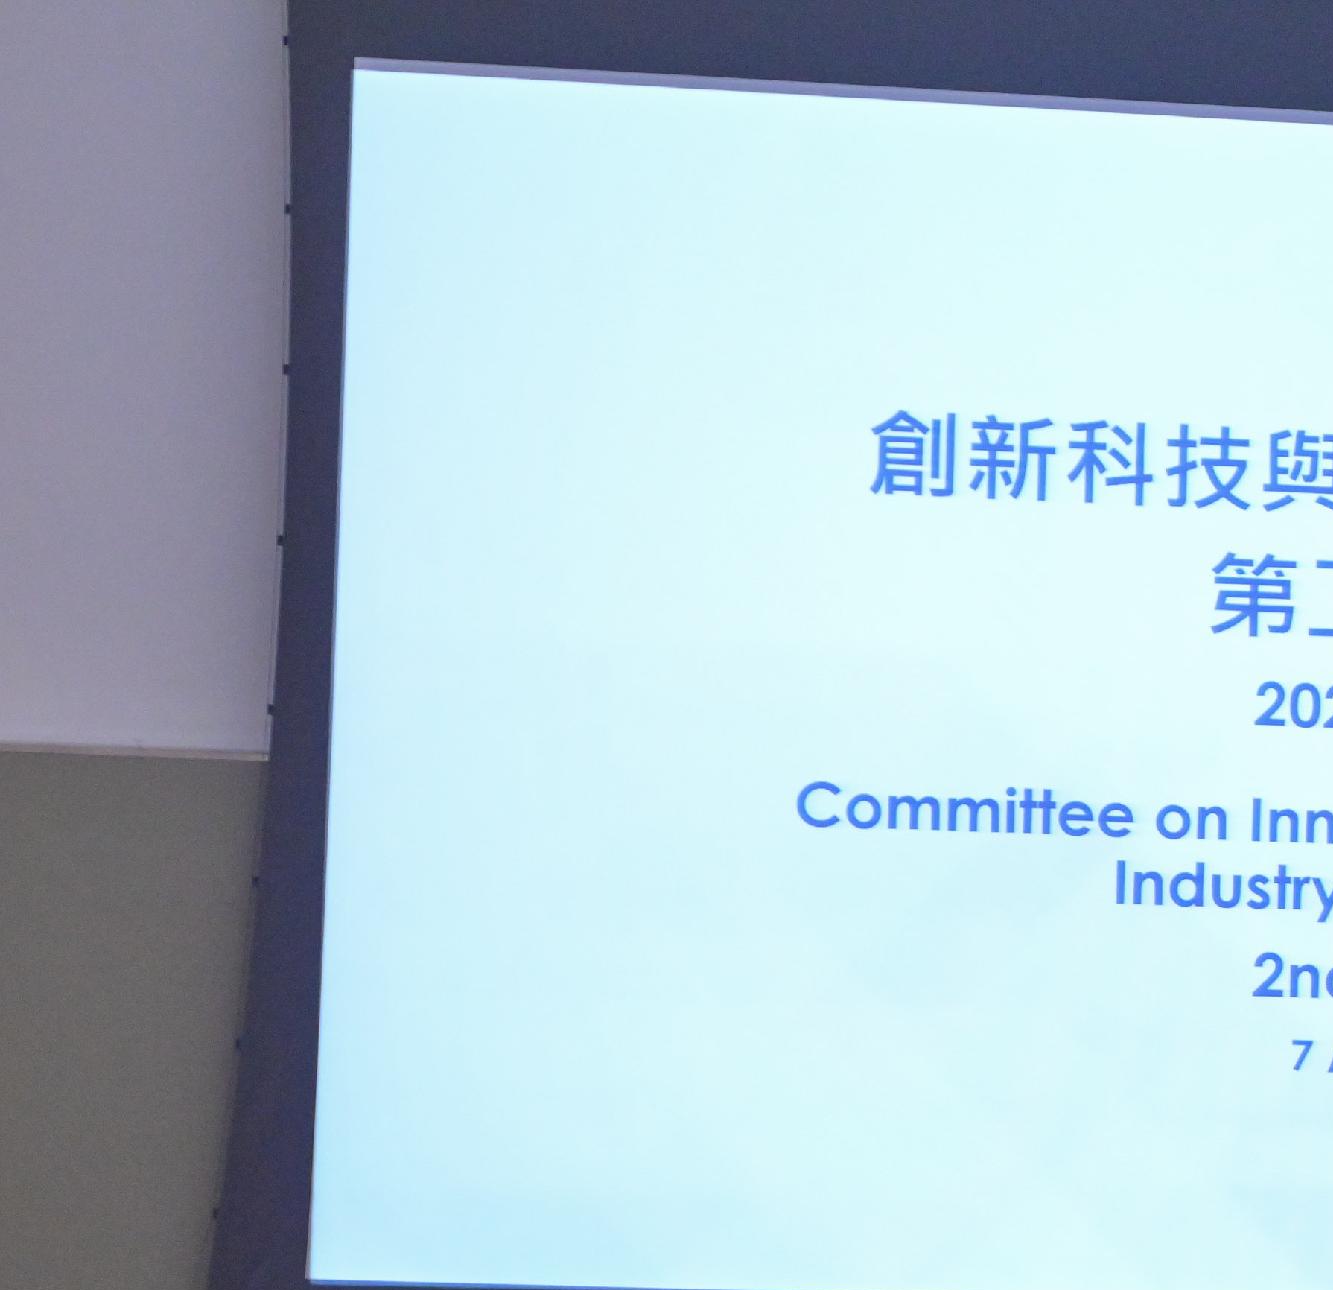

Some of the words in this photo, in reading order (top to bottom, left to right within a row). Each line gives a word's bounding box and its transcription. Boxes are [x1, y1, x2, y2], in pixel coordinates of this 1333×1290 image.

[797, 780, 1134, 838] Committee
[1156, 804, 1228, 841] on
[1292, 1039, 1314, 1071] 7
